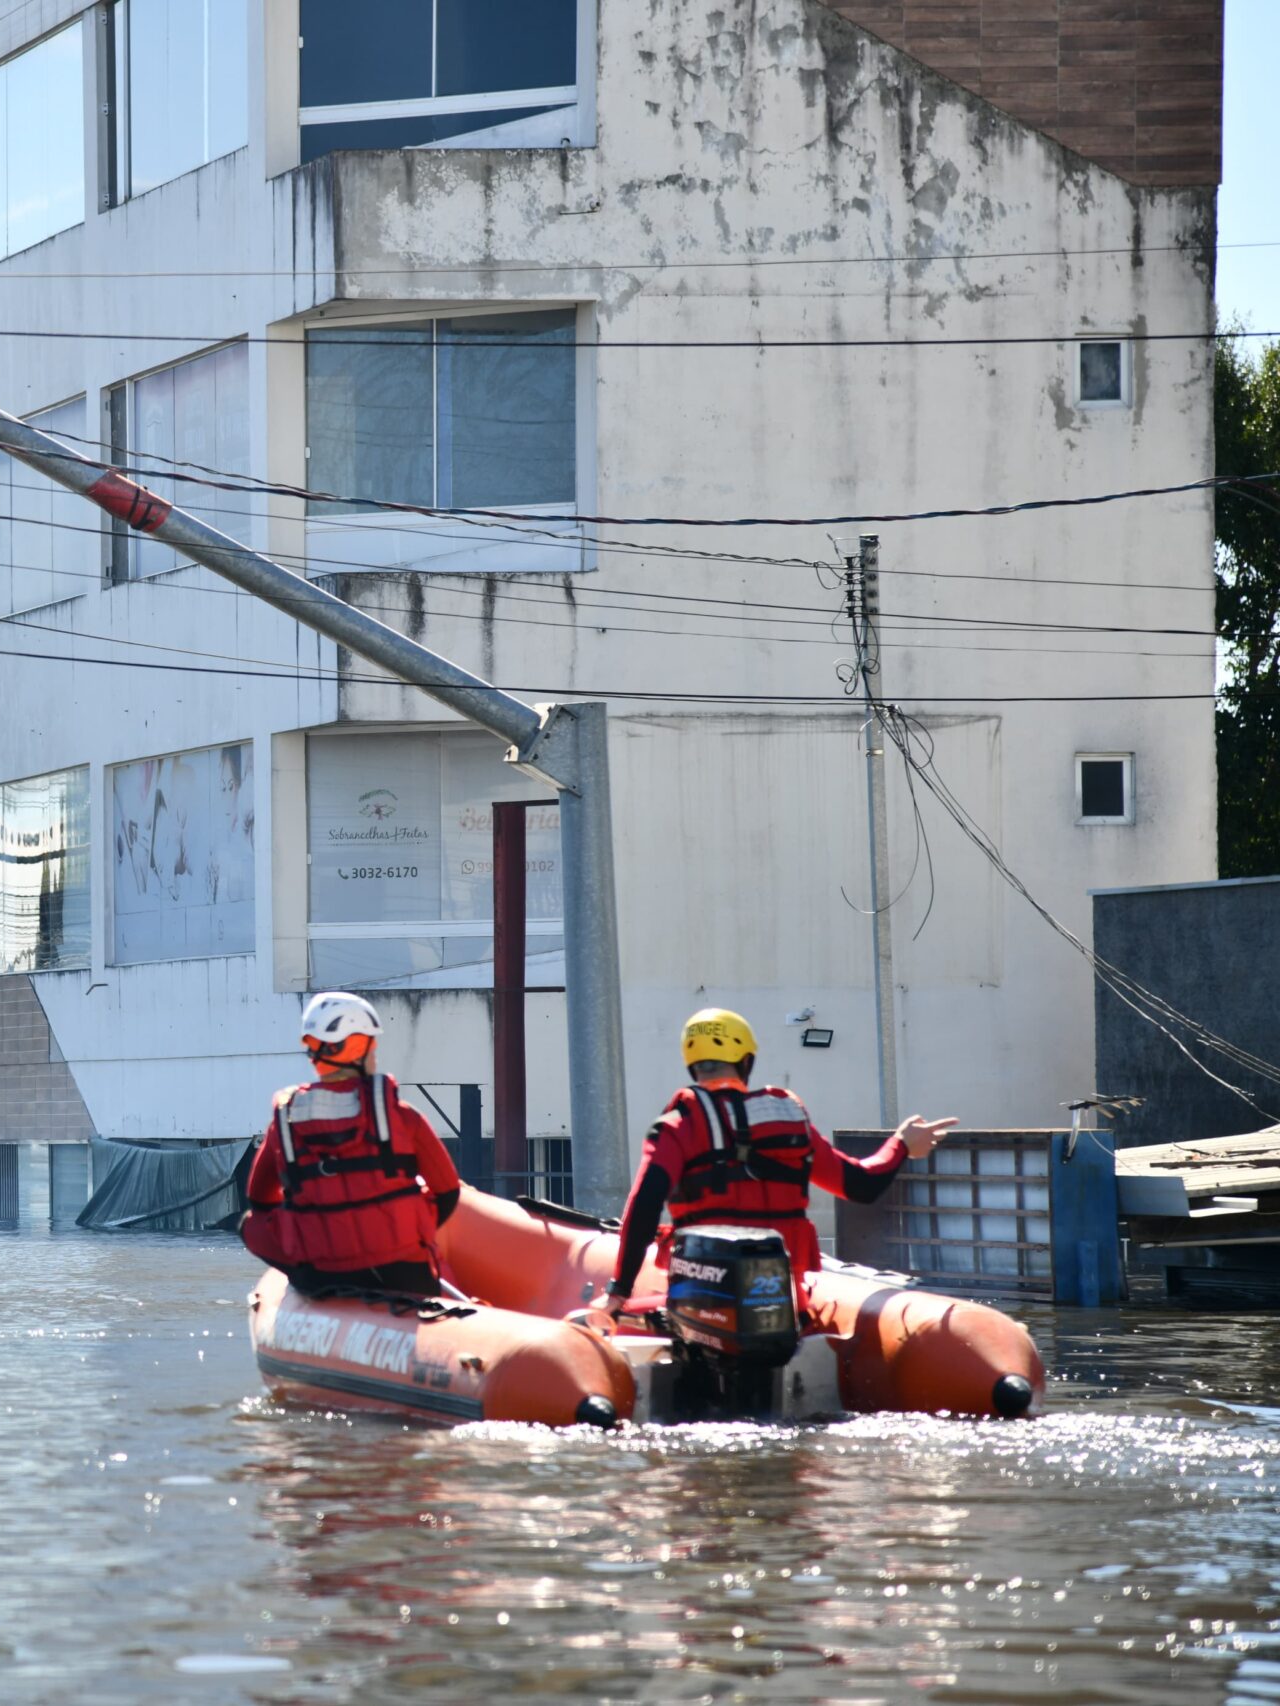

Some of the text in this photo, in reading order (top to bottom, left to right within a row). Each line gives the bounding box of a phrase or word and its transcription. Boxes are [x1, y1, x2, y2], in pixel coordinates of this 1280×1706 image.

[351, 866, 419, 879] 3032-6170
[670, 1257, 728, 1283] MERCURY
[749, 1276, 784, 1295] 25
[340, 1320, 417, 1374] MILITAR
